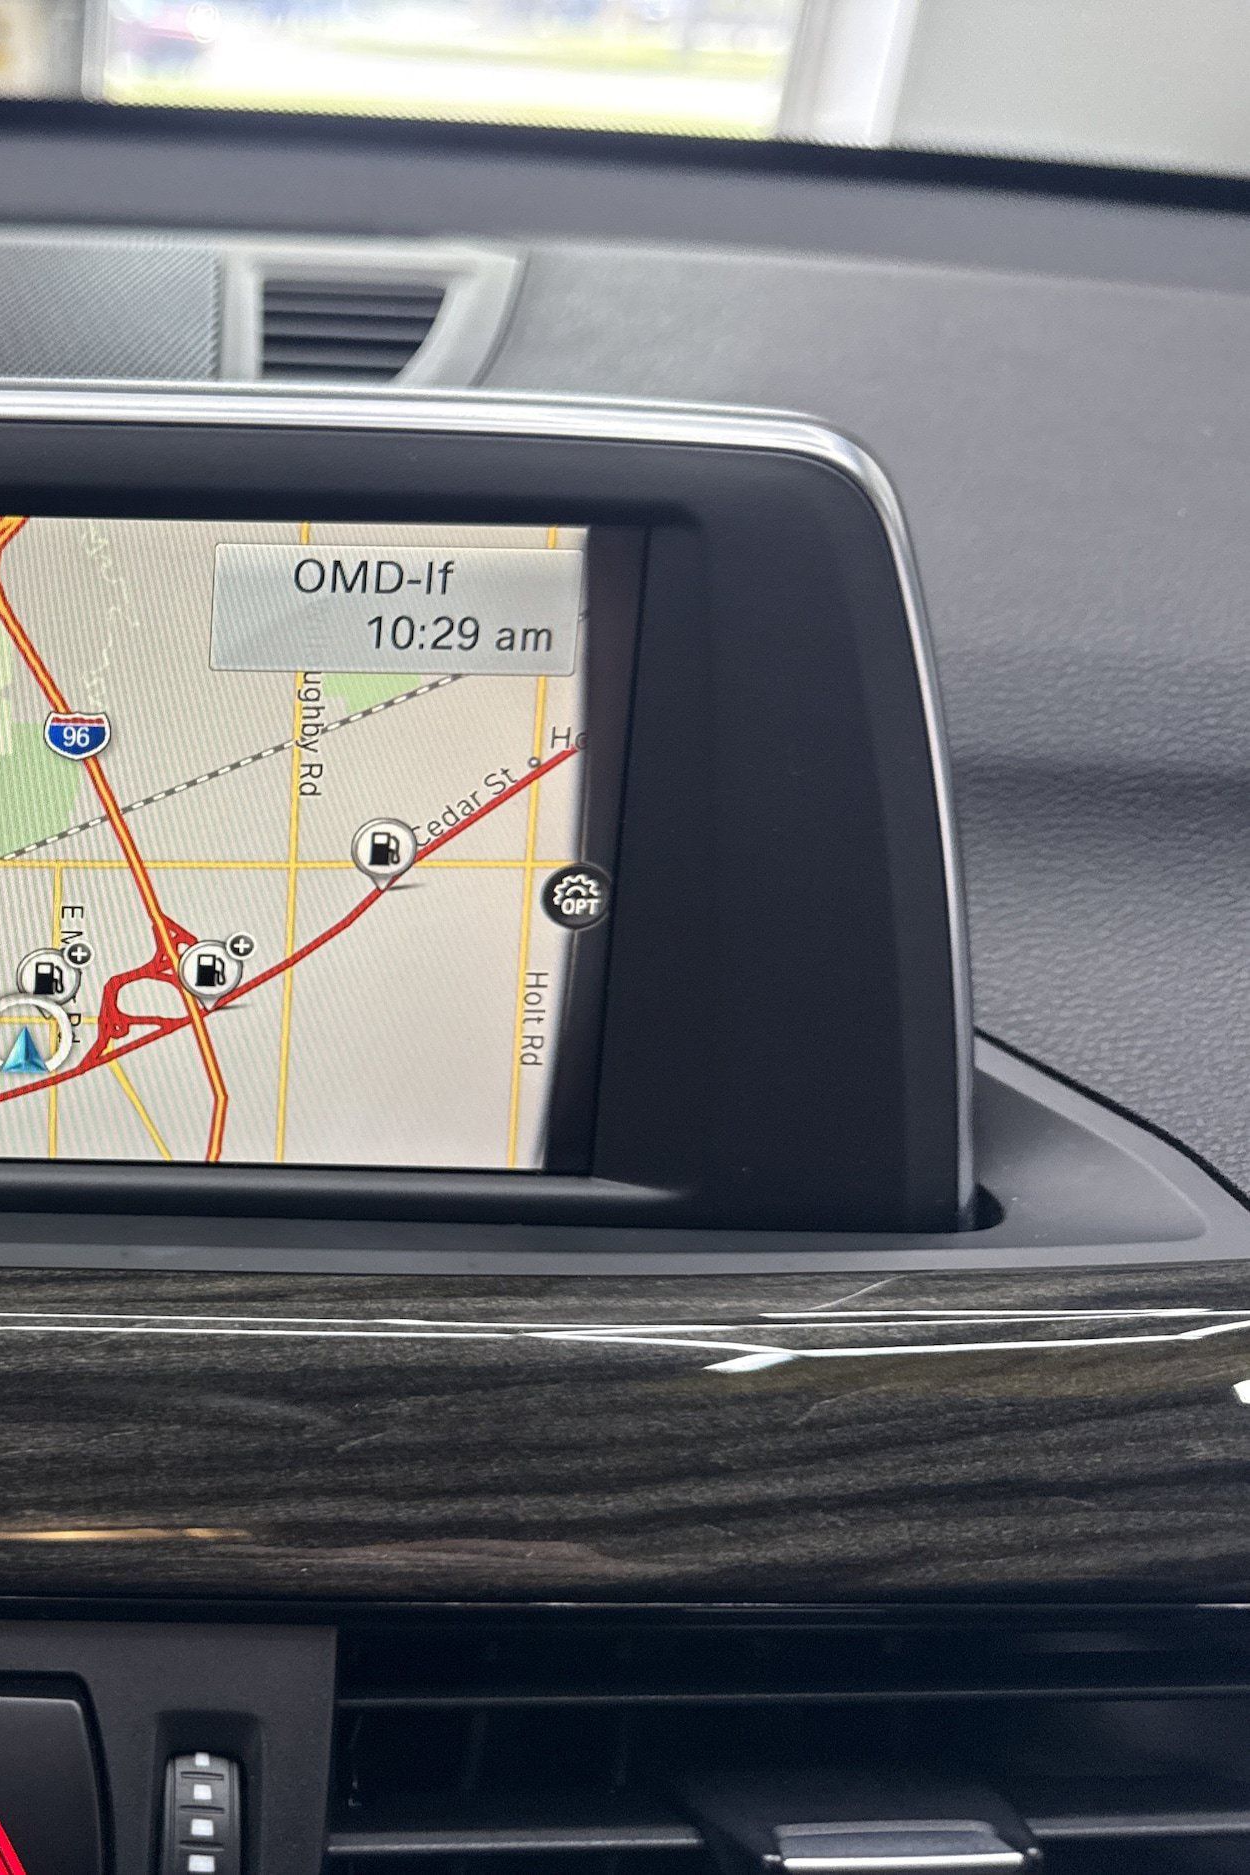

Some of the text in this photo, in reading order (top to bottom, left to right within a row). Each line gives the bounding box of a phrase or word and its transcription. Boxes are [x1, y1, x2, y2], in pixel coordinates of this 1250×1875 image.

[366, 615, 552, 652] 10:29 am
[62, 726, 91, 748] 96
[299, 763, 323, 797] Rd
[483, 767, 518, 795] St
[61, 905, 84, 919] E
[560, 898, 600, 916] OPT
[519, 971, 550, 1066] Holt Rd
